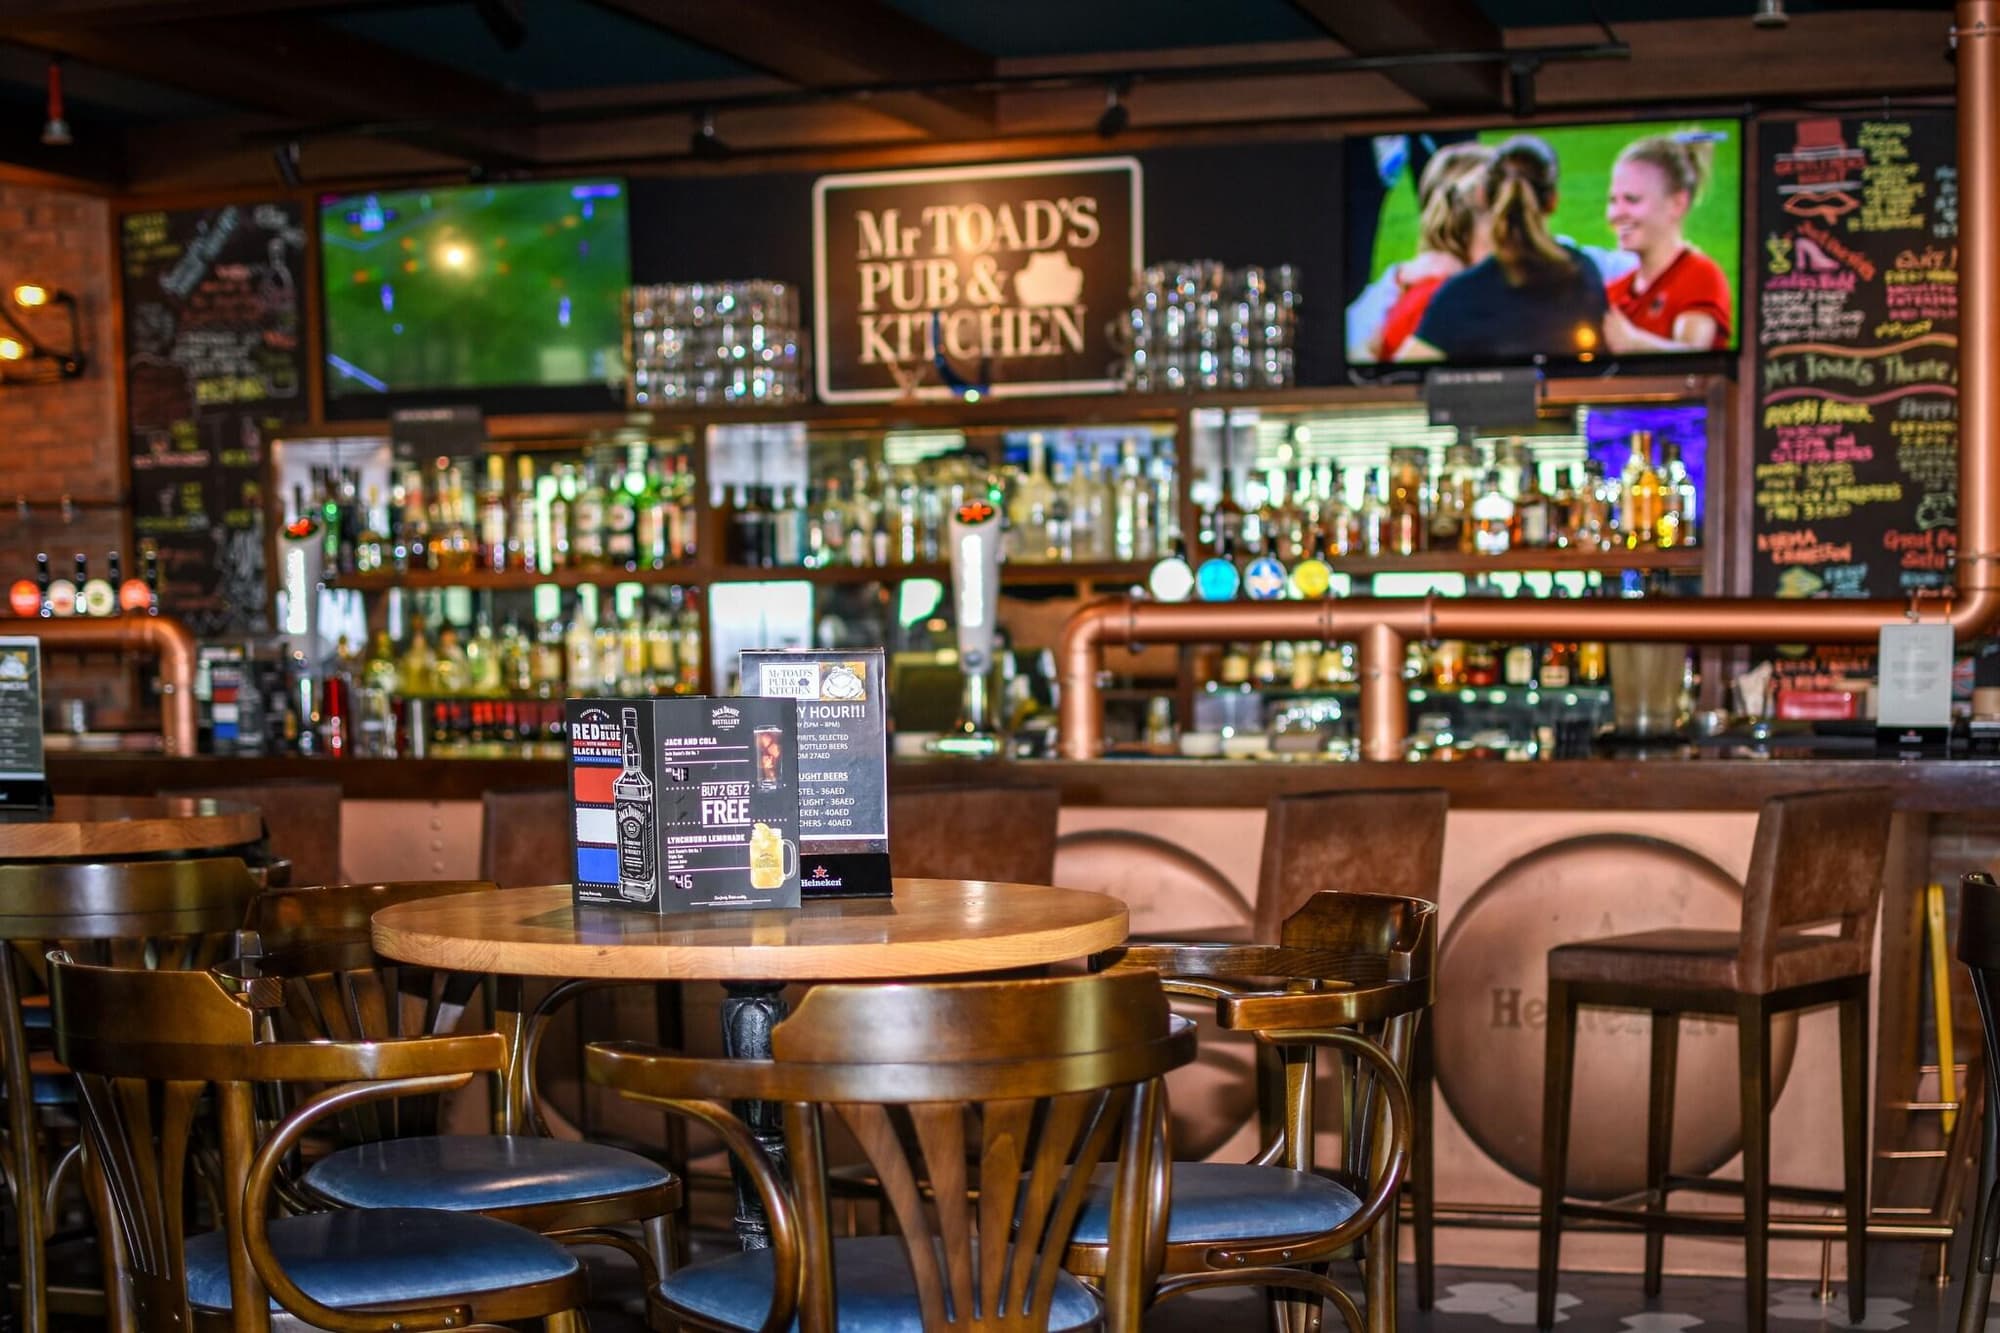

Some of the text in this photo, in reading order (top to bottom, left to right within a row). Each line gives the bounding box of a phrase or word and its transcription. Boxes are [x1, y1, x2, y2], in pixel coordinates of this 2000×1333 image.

[856, 196, 1100, 259] Mr TOAD'S
[858, 255, 1008, 311] PUB &
[858, 304, 1087, 364] KITCHEN
[780, 670, 812, 678] TOAD'S
[769, 686, 810, 695] KITCHEN
[796, 705, 865, 718] Y HOUR!!!
[572, 723, 600, 740] RED
[600, 731, 621, 740] BLUE
[573, 747, 594, 755] BLACK
[602, 748, 622, 756] WHITE
[798, 772, 848, 780] UGHT BEERS
[702, 784, 750, 796] BUY 2 GET 2
[702, 800, 750, 824] FREE
[800, 820, 821, 828] CHERS
[668, 834, 745, 844] LYNCHBURG LEMONADE
[675, 874, 692, 888] 46
[801, 878, 842, 887] Heineken
